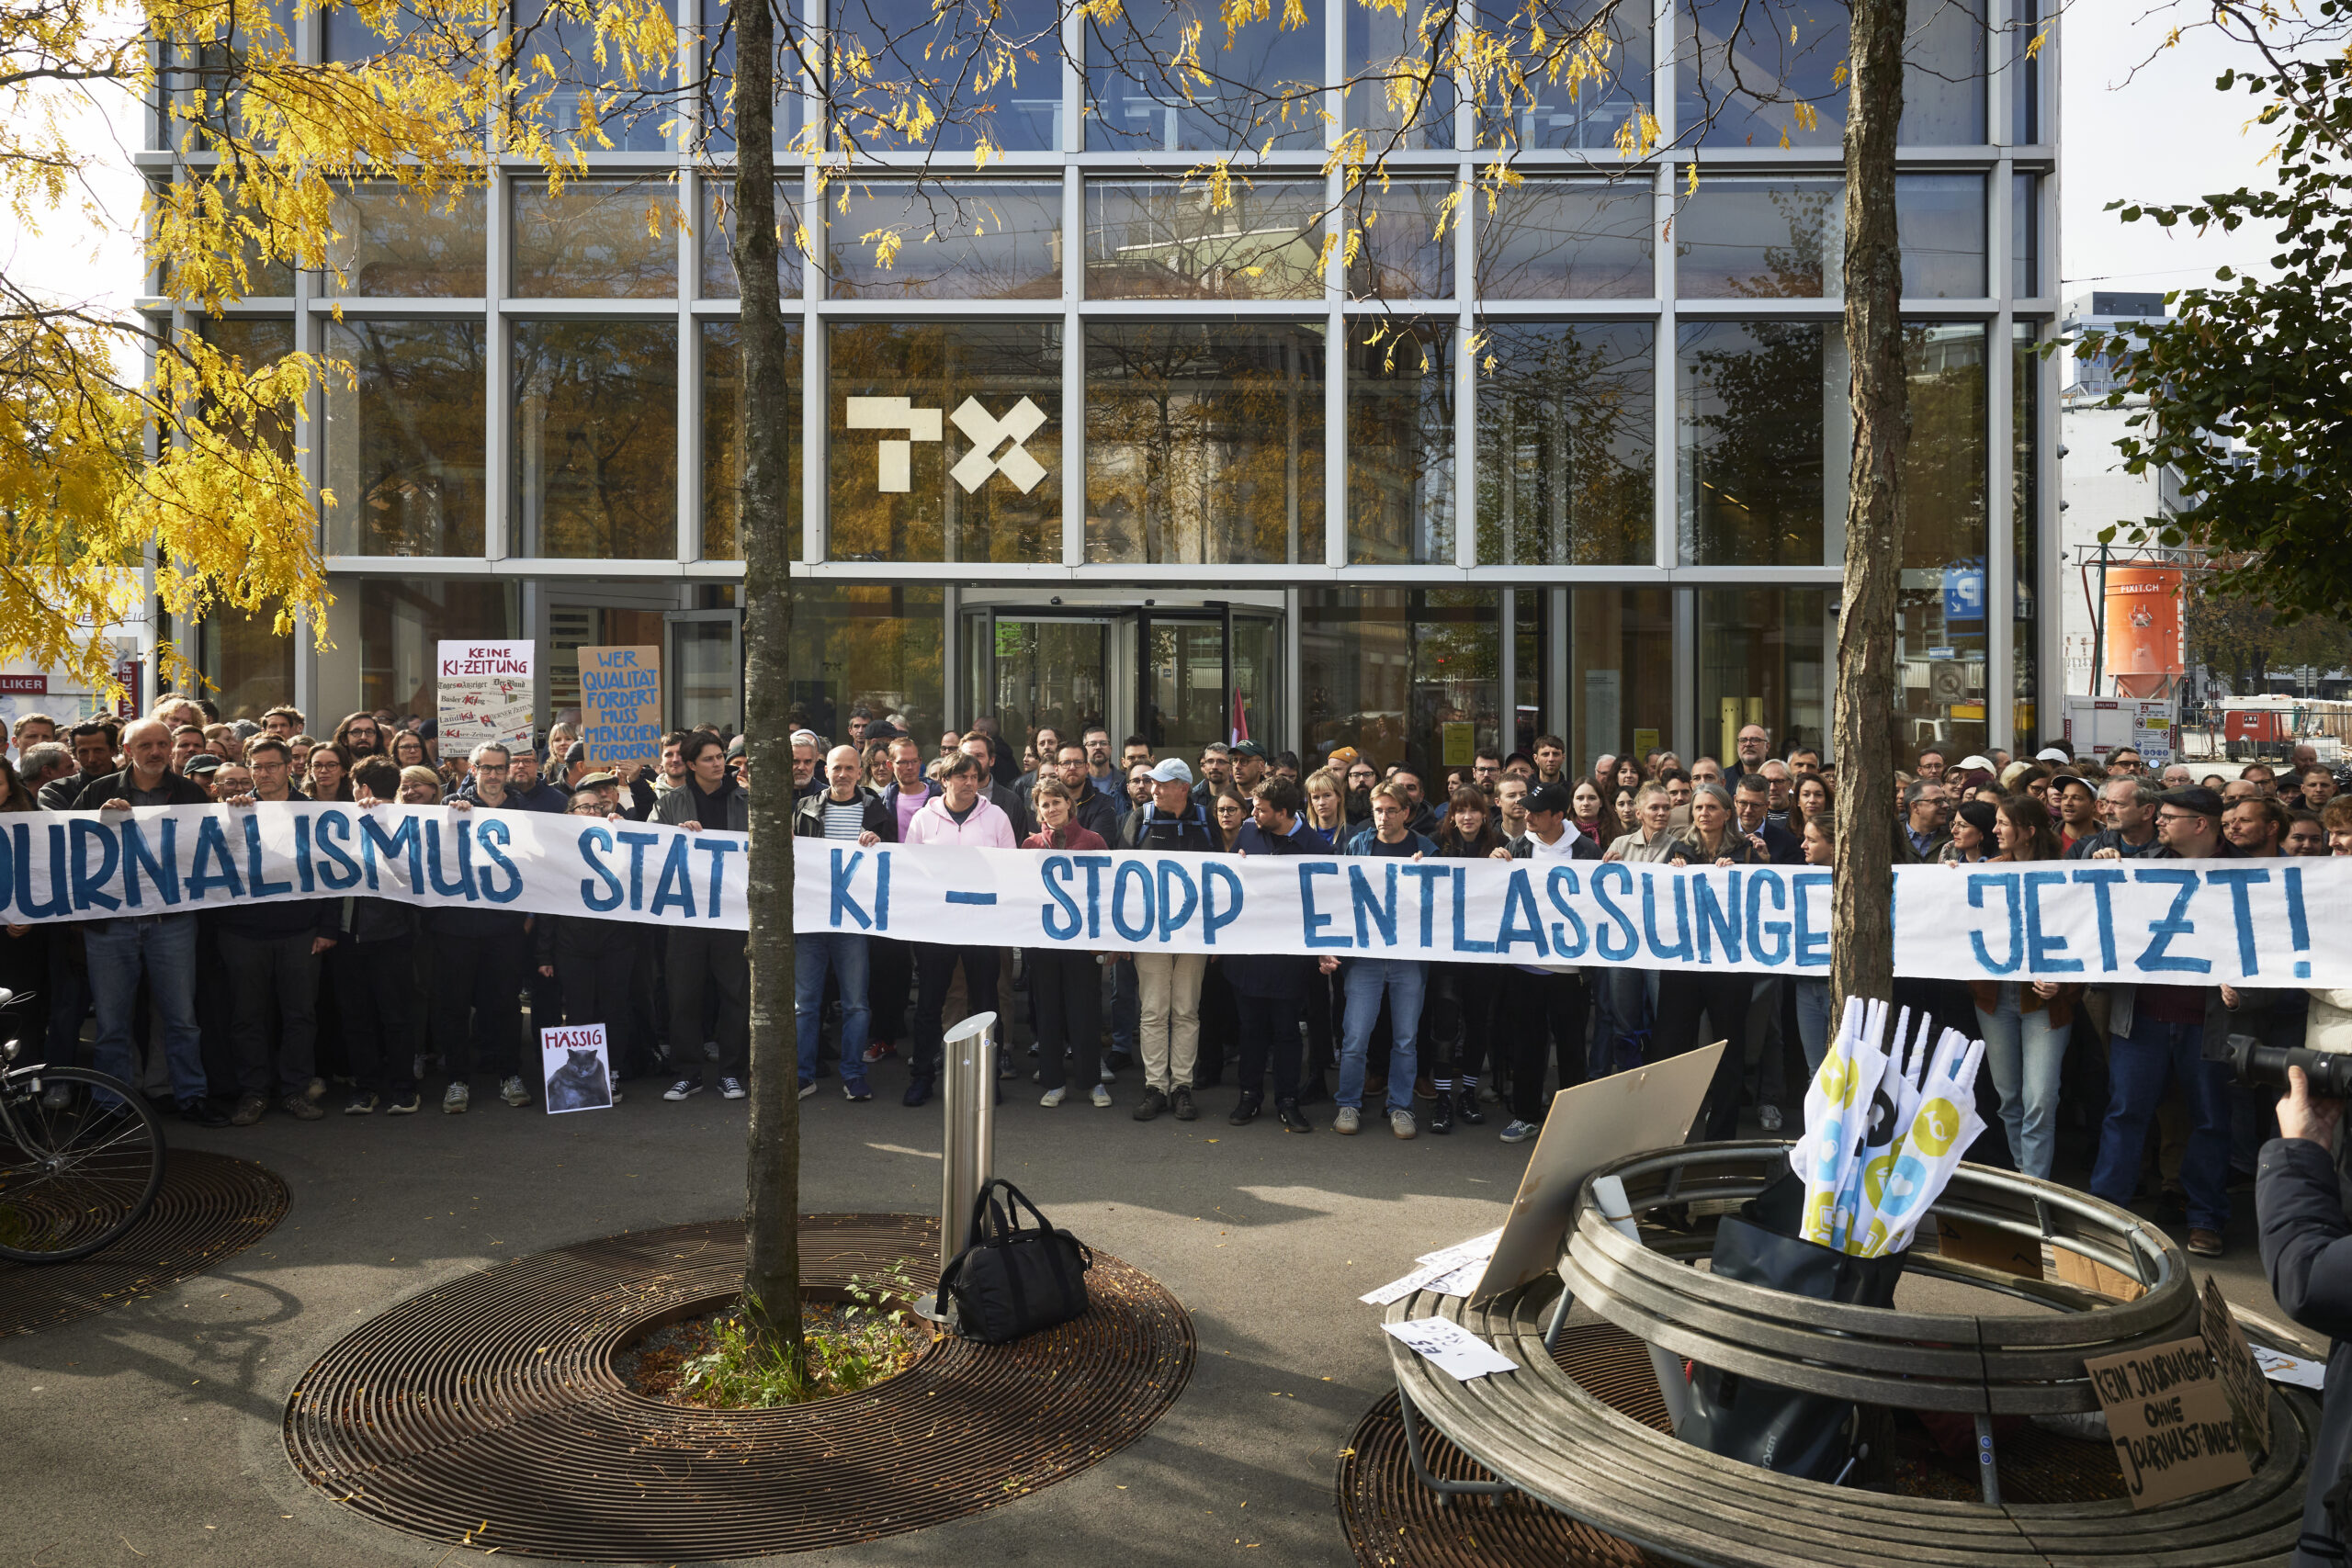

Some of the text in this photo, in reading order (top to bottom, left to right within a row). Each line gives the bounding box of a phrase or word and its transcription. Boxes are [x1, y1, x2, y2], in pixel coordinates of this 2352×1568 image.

[2120, 584, 2159, 593] FIXIT.CH
[469, 648, 511, 659] KEINE
[597, 650, 639, 668] WER
[443, 660, 528, 676] KI-ZEITUNG
[0, 679, 43, 689] LIKER
[582, 669, 658, 691] QUALITÄT
[586, 688, 658, 708] FORDERT
[600, 707, 639, 724] MUSS
[584, 724, 662, 743] MENSCHEN
[589, 743, 661, 761] FÖRDERN
[577, 827, 749, 919] STAT
[830, 848, 892, 931] KI
[1041, 855, 1244, 944] STOPP
[1299, 862, 1898, 967] ENTLASSUNGE
[1967, 867, 2312, 979] JETZT!
[545, 1029, 603, 1049] HÄSSIG
[2093, 1361, 2134, 1404] KEIN
[2127, 1348, 2216, 1398] JOURNALISMUS
[2143, 1396, 2184, 1428] OHNE
[2115, 1420, 2244, 1496] JOURNALIST:INNEN
